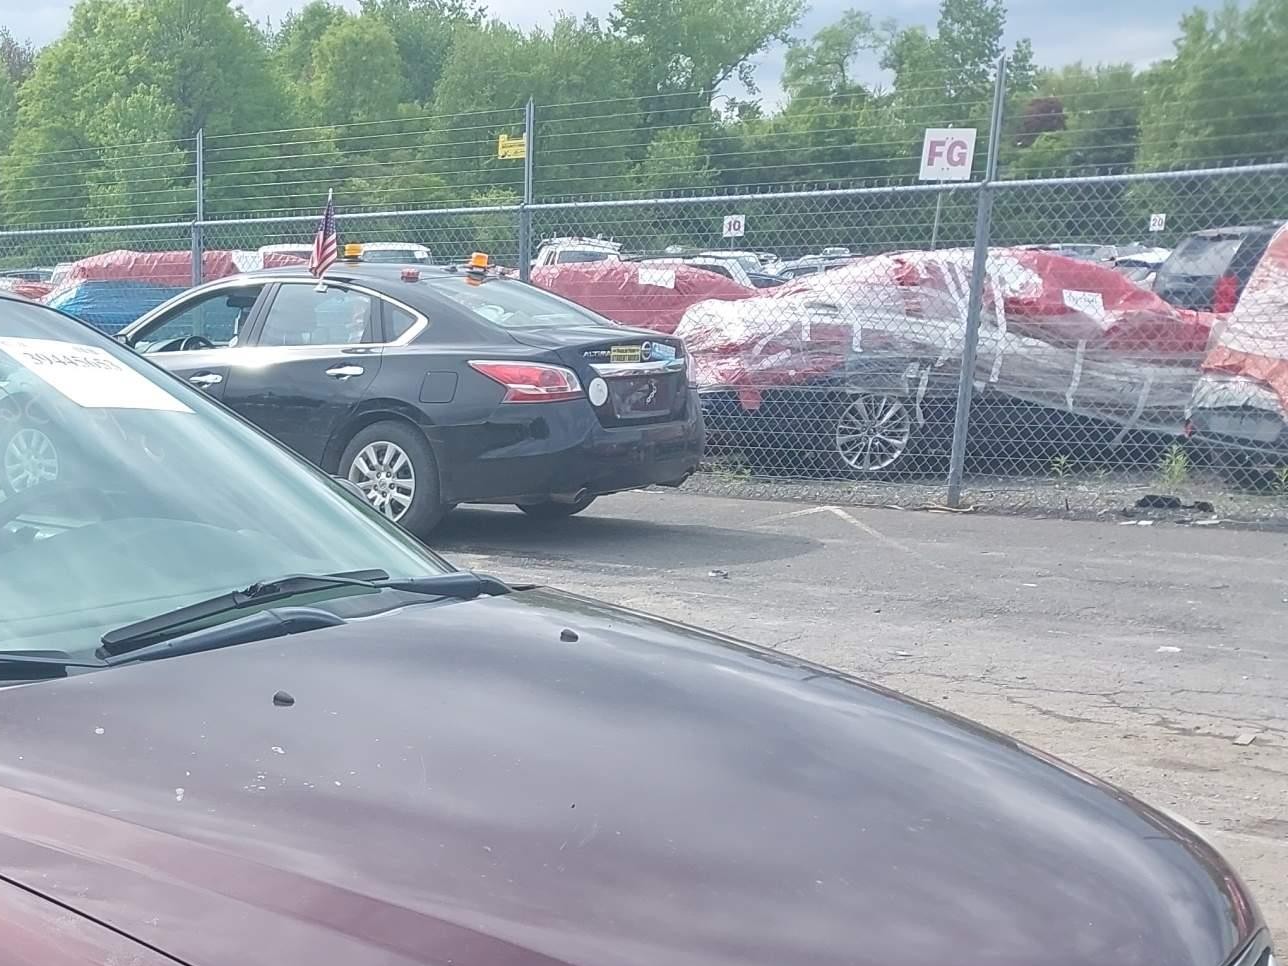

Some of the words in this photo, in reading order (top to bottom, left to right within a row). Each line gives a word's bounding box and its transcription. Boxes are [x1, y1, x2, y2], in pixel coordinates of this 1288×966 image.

[927, 140, 968, 167] FG
[727, 220, 741, 231] 10
[1152, 217, 1164, 226] 20
